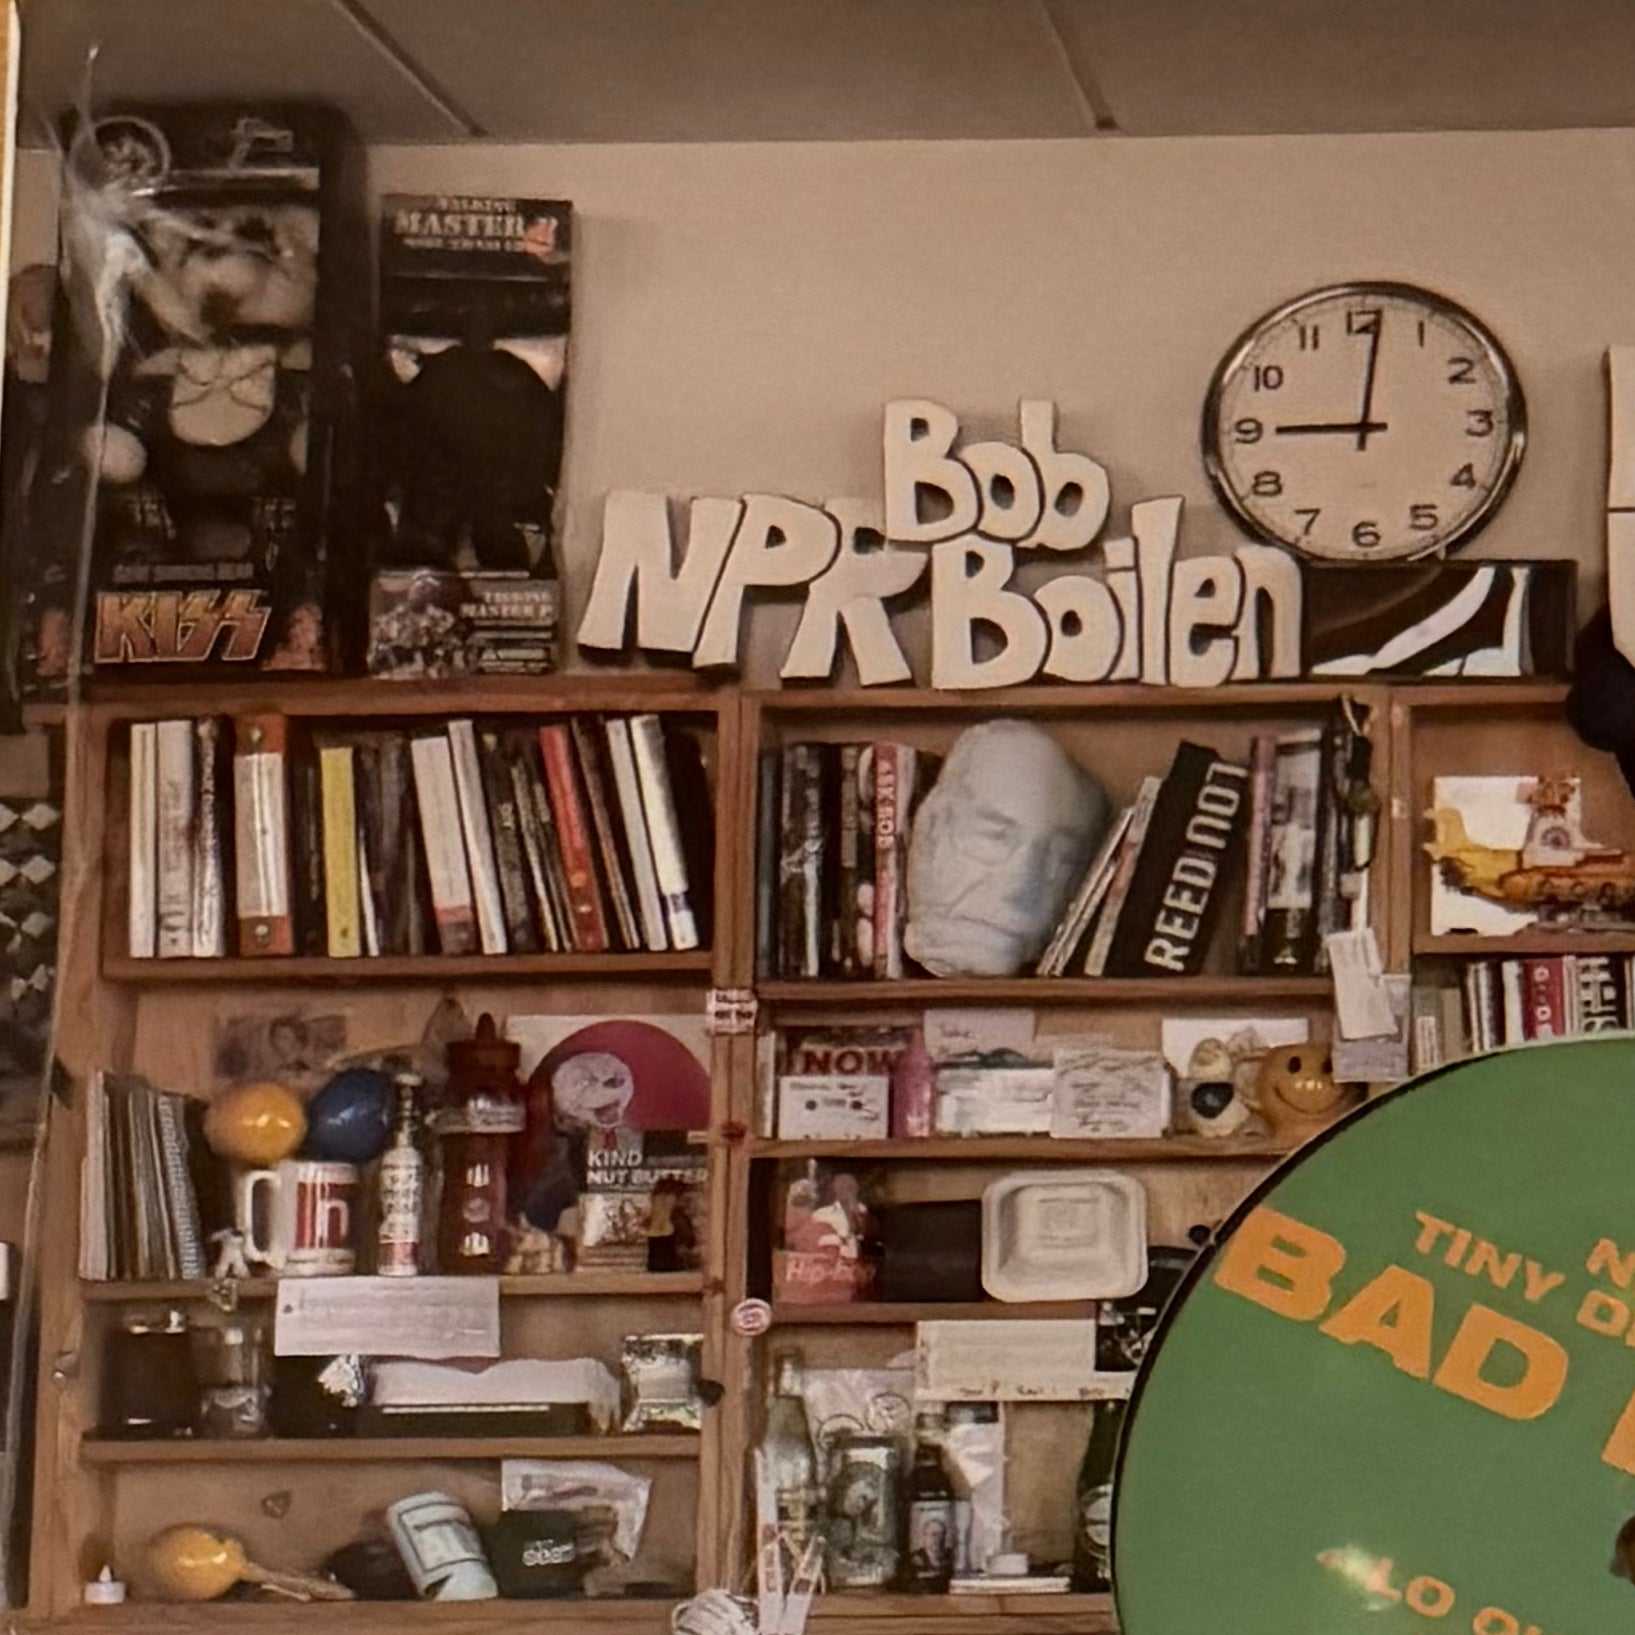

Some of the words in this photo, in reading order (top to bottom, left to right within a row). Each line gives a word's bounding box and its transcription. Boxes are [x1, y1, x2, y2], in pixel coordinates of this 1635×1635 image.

[1299, 324, 1319, 351] 11
[1416, 319, 1426, 348] 1
[1253, 364, 1285, 391] 10
[1446, 356, 1478, 385] 2
[1234, 417, 1264, 444] 9
[1464, 409, 1495, 437] 3
[884, 398, 1110, 552] Bob
[1251, 470, 1284, 498] 8
[1449, 462, 1478, 490] 4
[1293, 507, 1322, 537] 7
[1409, 503, 1440, 531] 5
[1351, 521, 1382, 548] 6
[576, 489, 930, 687] NPR
[930, 495, 1302, 691] Boilen
[94, 588, 272, 665] KISS
[1143, 855, 1217, 972] REED
[587, 1150, 643, 1167] KIND
[586, 1168, 629, 1184] NUT
[1415, 1210, 1565, 1303] TINY
[1213, 1205, 1569, 1420] BAD
